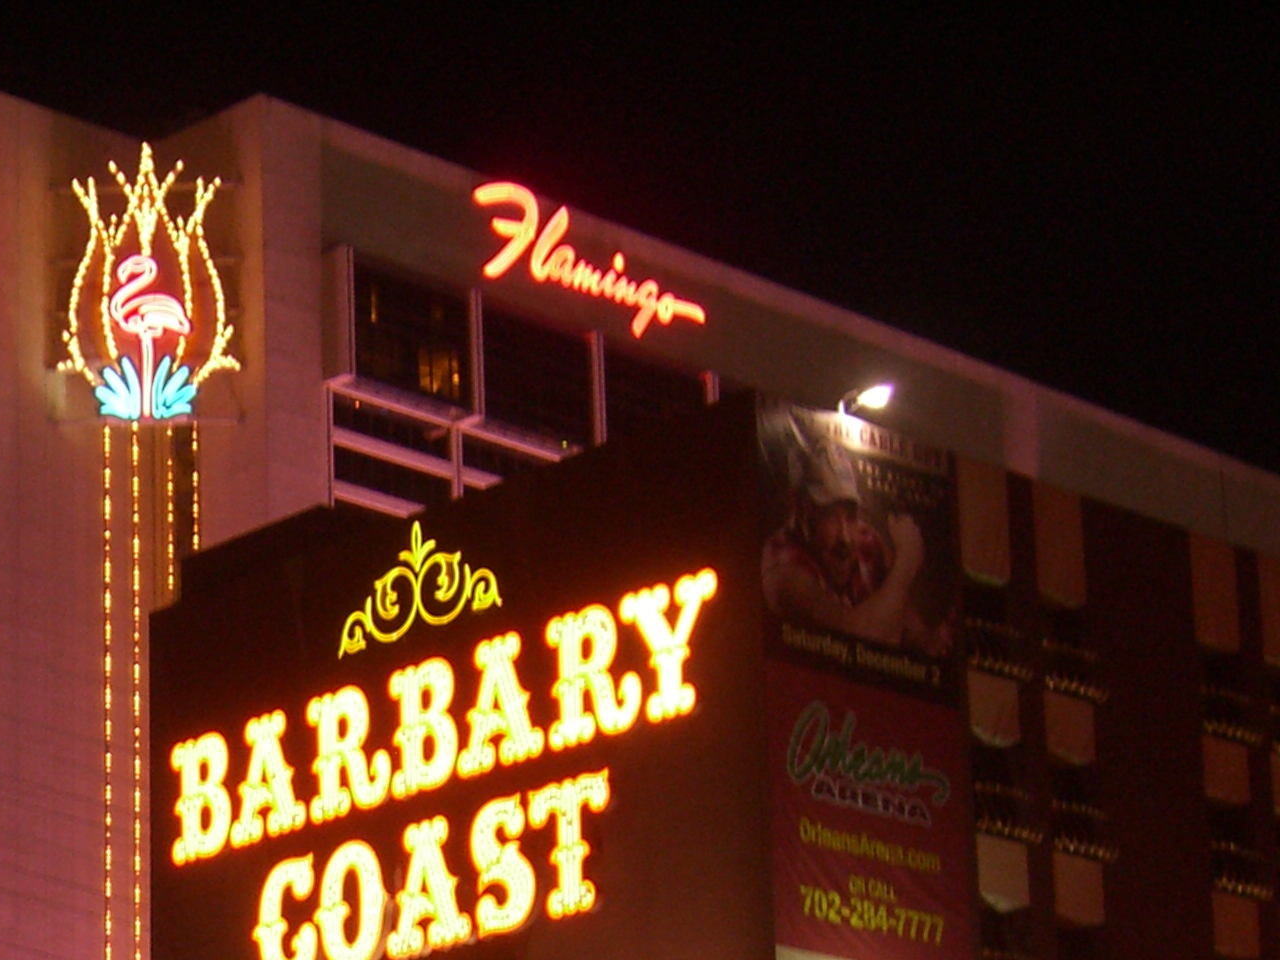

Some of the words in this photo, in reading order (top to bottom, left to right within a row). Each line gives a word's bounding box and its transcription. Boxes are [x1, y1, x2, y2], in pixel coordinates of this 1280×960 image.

[473, 181, 706, 339] Flamingo
[169, 567, 718, 866] BARBARY
[787, 700, 950, 808] Orleans
[799, 817, 941, 873] OrleansArena.com
[800, 884, 945, 947] 702-284-7777
